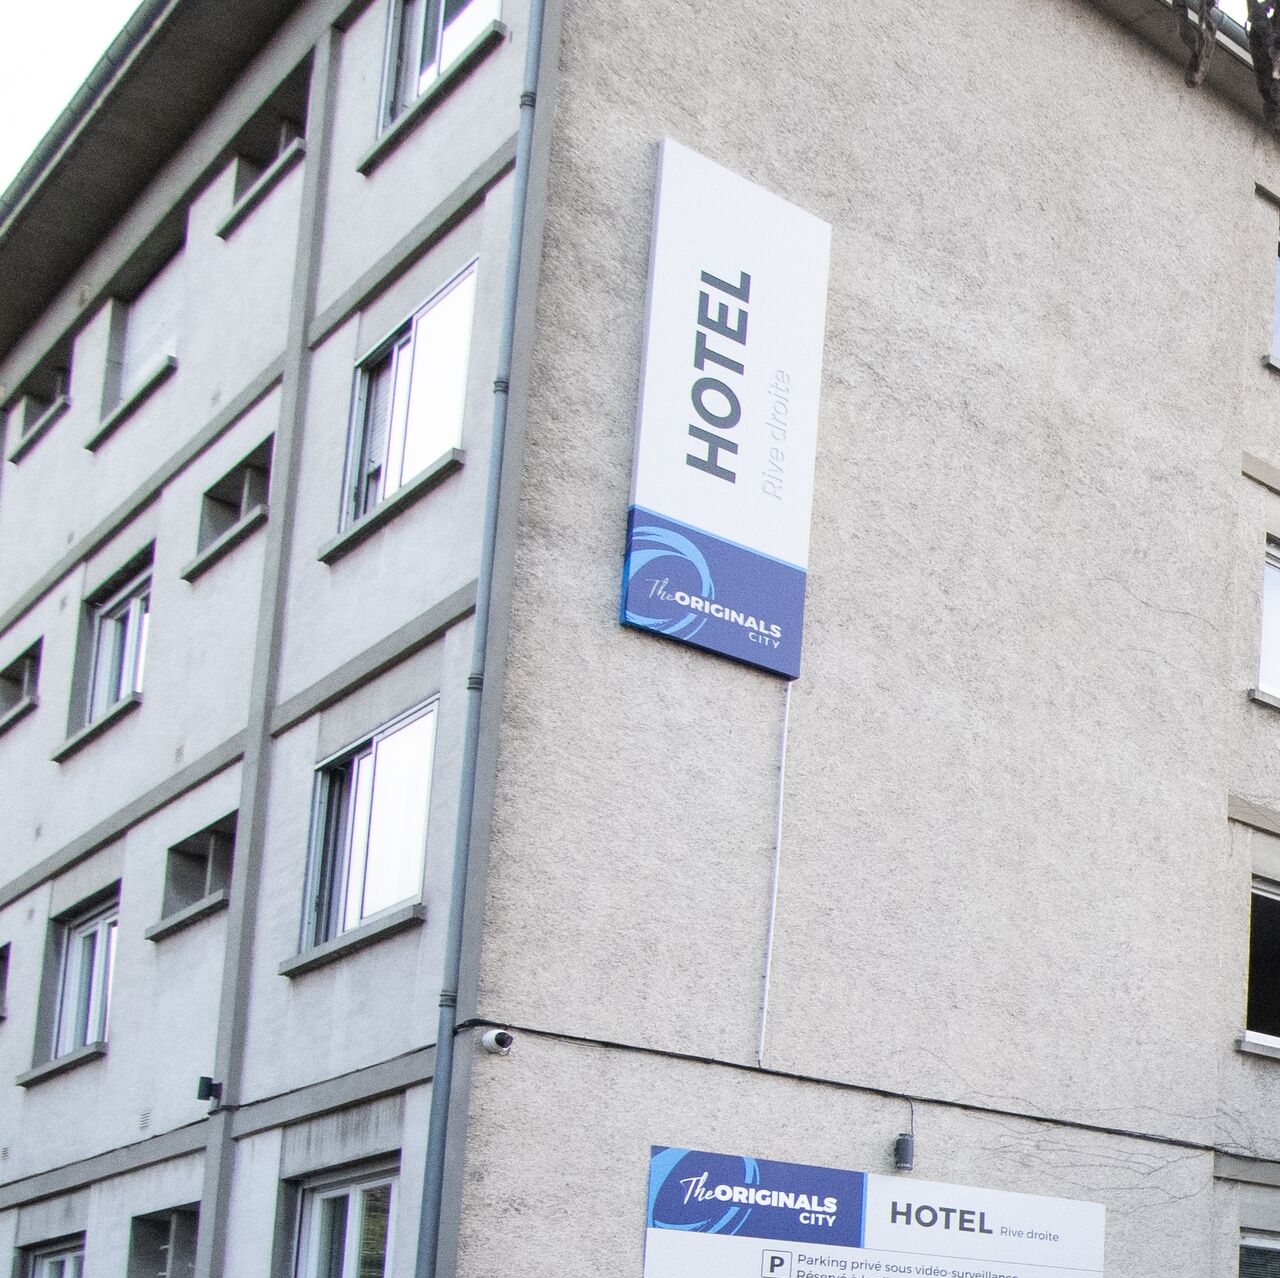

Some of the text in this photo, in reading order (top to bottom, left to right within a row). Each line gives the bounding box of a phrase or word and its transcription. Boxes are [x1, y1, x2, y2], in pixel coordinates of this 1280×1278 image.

[686, 270, 751, 484] HOTEL
[762, 369, 791, 500] Rive droite
[674, 591, 782, 638] ORIGINALS
[748, 632, 780, 649] CITY
[714, 1184, 838, 1213] ORIGINALS
[799, 1212, 836, 1227] CITY
[891, 1201, 1060, 1242] HOTEL Rive droite
[769, 1255, 785, 1273] P
[797, 1254, 848, 1270] Parking
[851, 1259, 881, 1271] privé
[885, 1264, 912, 1274] sous
